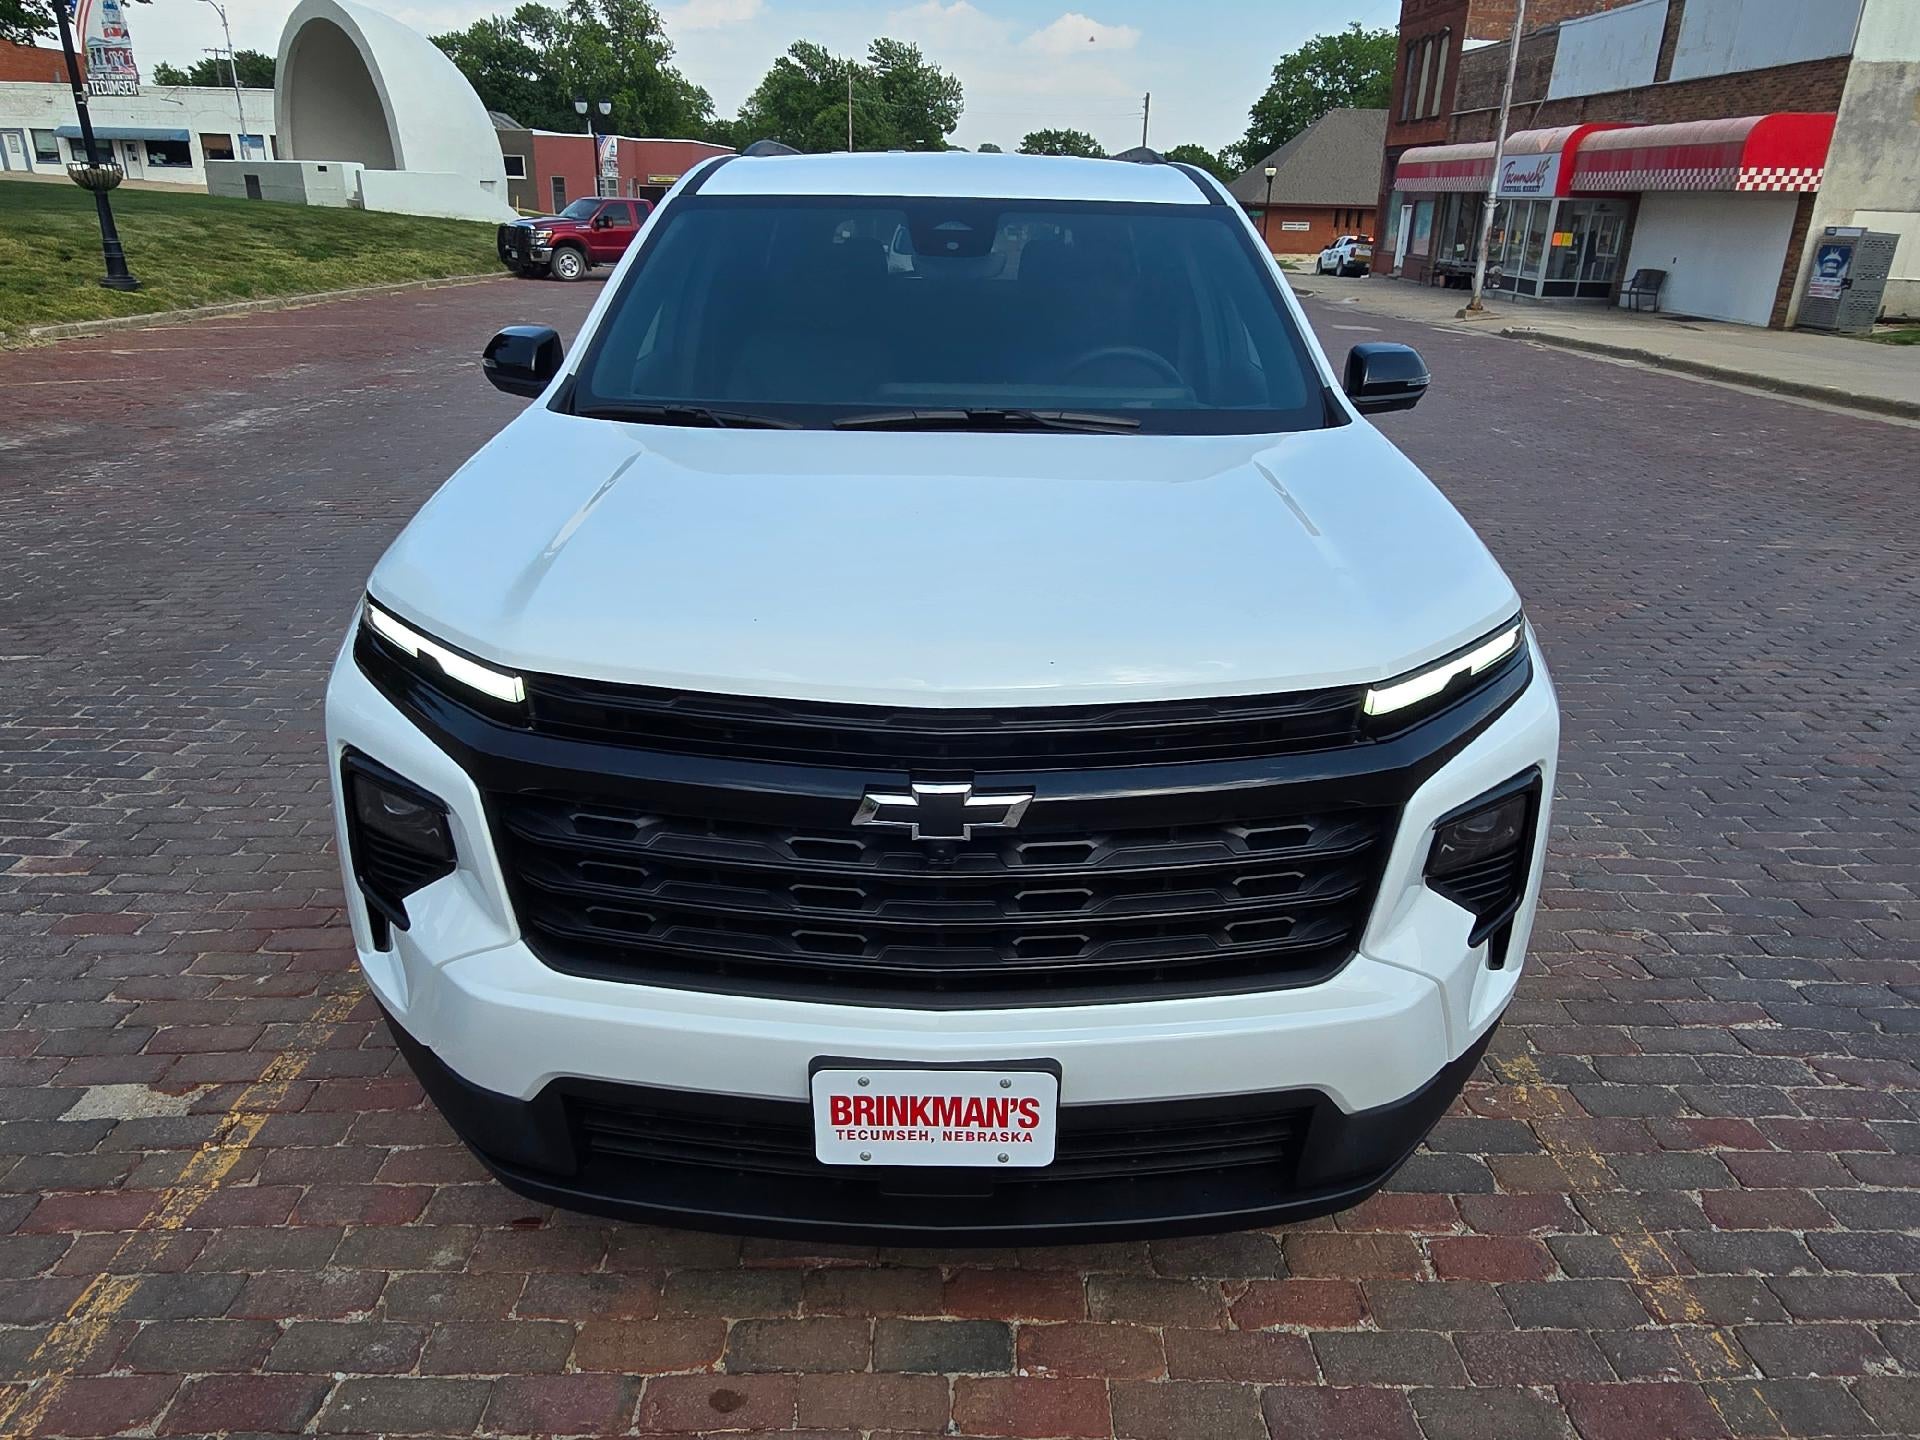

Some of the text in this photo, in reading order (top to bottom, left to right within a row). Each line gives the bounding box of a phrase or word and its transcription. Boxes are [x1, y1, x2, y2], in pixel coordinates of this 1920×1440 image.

[88, 80, 137, 95] TECUMSEH
[1502, 160, 1543, 192] Tecumseh
[830, 1095, 1041, 1129] BRINKMAN'S
[835, 1129, 1033, 1143] TECUMSEH, NEBRASKA
